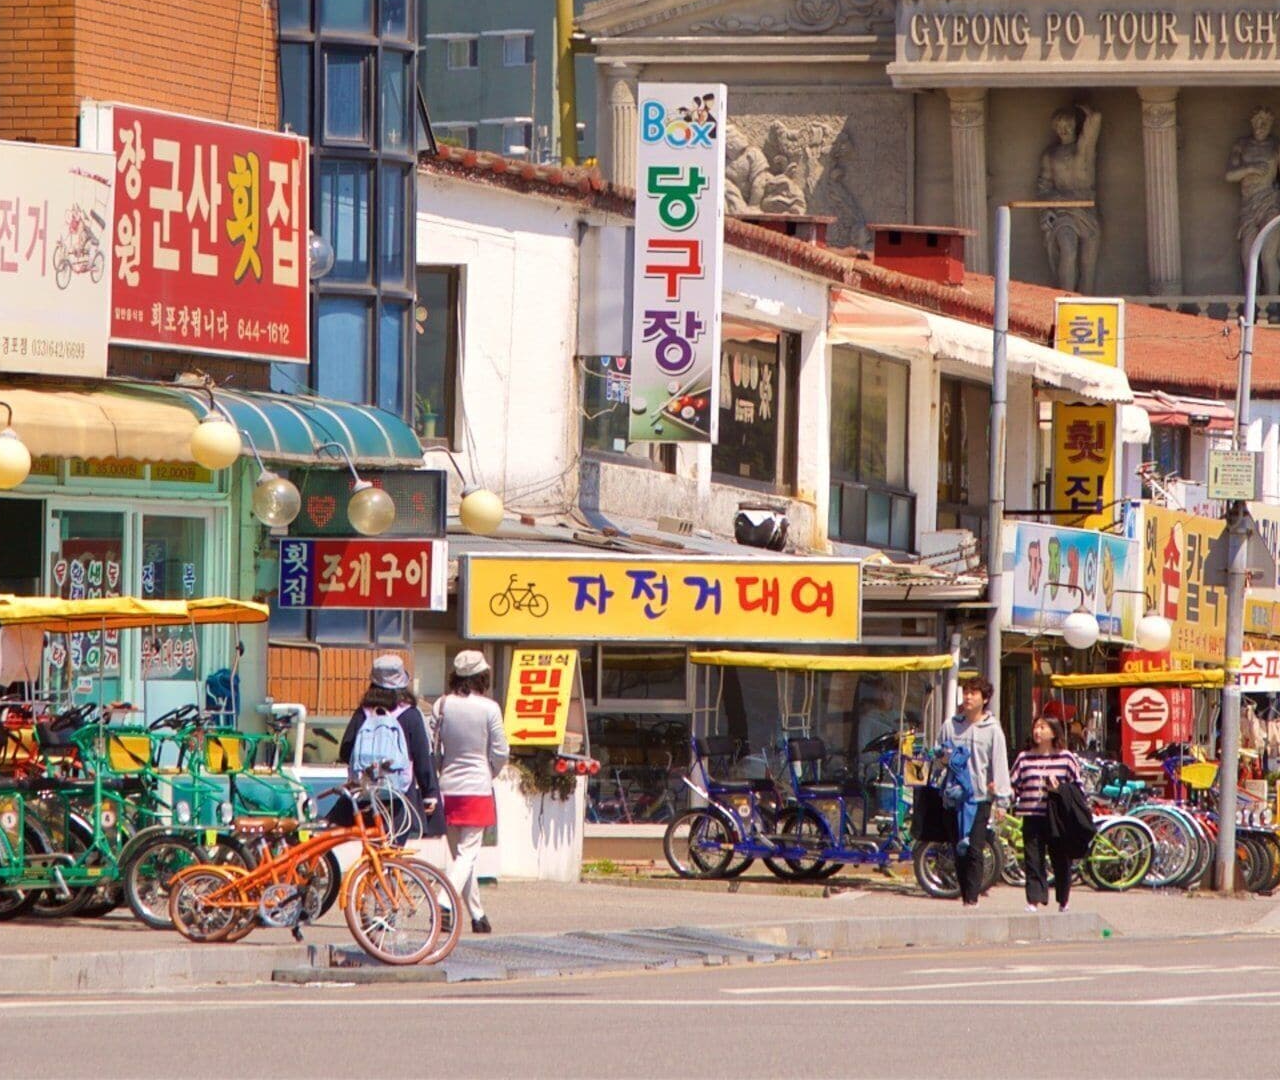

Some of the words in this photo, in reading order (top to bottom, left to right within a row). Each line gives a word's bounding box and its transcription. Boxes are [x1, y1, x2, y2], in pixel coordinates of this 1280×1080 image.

[910, 11, 1032, 48] GYEONG
[1045, 10, 1085, 46] PO
[1099, 9, 1179, 46] TOUR
[113, 119, 146, 289] 장원
[147, 136, 302, 289] 군산횟집
[642, 164, 708, 377] 당구장
[151, 301, 230, 342] 회포장됩니다
[237, 317, 291, 345] 644-1612
[283, 542, 309, 606] 횟집
[318, 551, 429, 598] 조개구이
[515, 669, 562, 726] 민박
